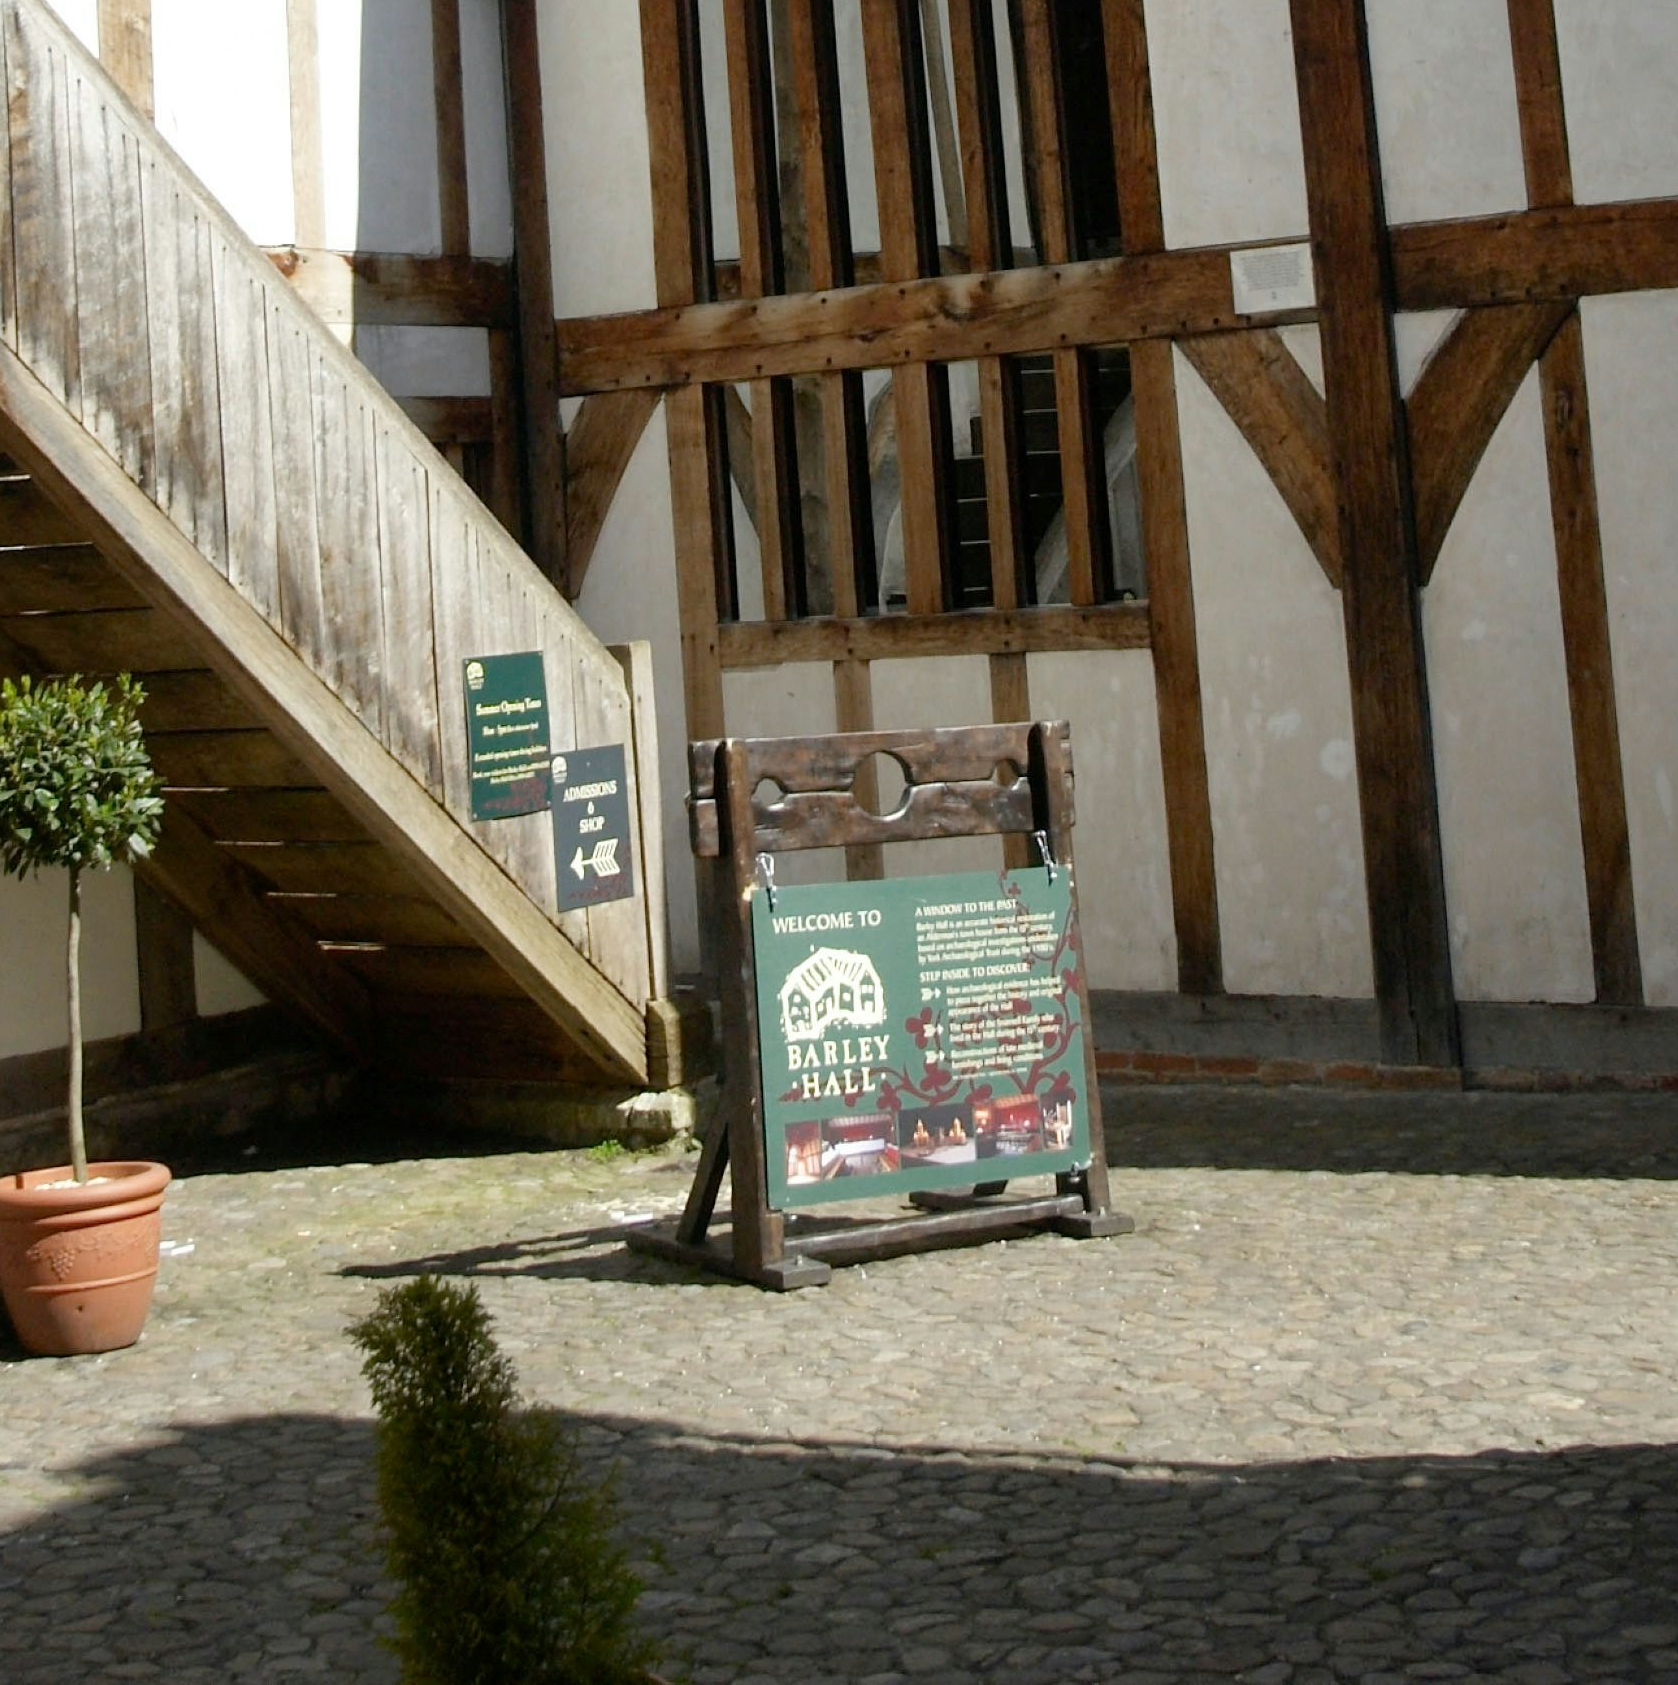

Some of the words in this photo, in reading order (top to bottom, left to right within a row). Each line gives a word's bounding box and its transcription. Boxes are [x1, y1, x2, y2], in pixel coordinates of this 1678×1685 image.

[563, 780, 617, 803] ADMISSIONS
[579, 815, 606, 834] SHOP
[923, 903, 962, 916] WINDOW
[964, 902, 977, 913] TO
[979, 901, 996, 912] THE
[996, 898, 1018, 910] PAST
[772, 912, 854, 935] WELCOME
[857, 910, 882, 927] TO
[920, 970, 941, 983] STEP
[942, 968, 971, 981] INSIDE
[972, 966, 985, 977] TO
[787, 1035, 891, 1070] BARLEY
